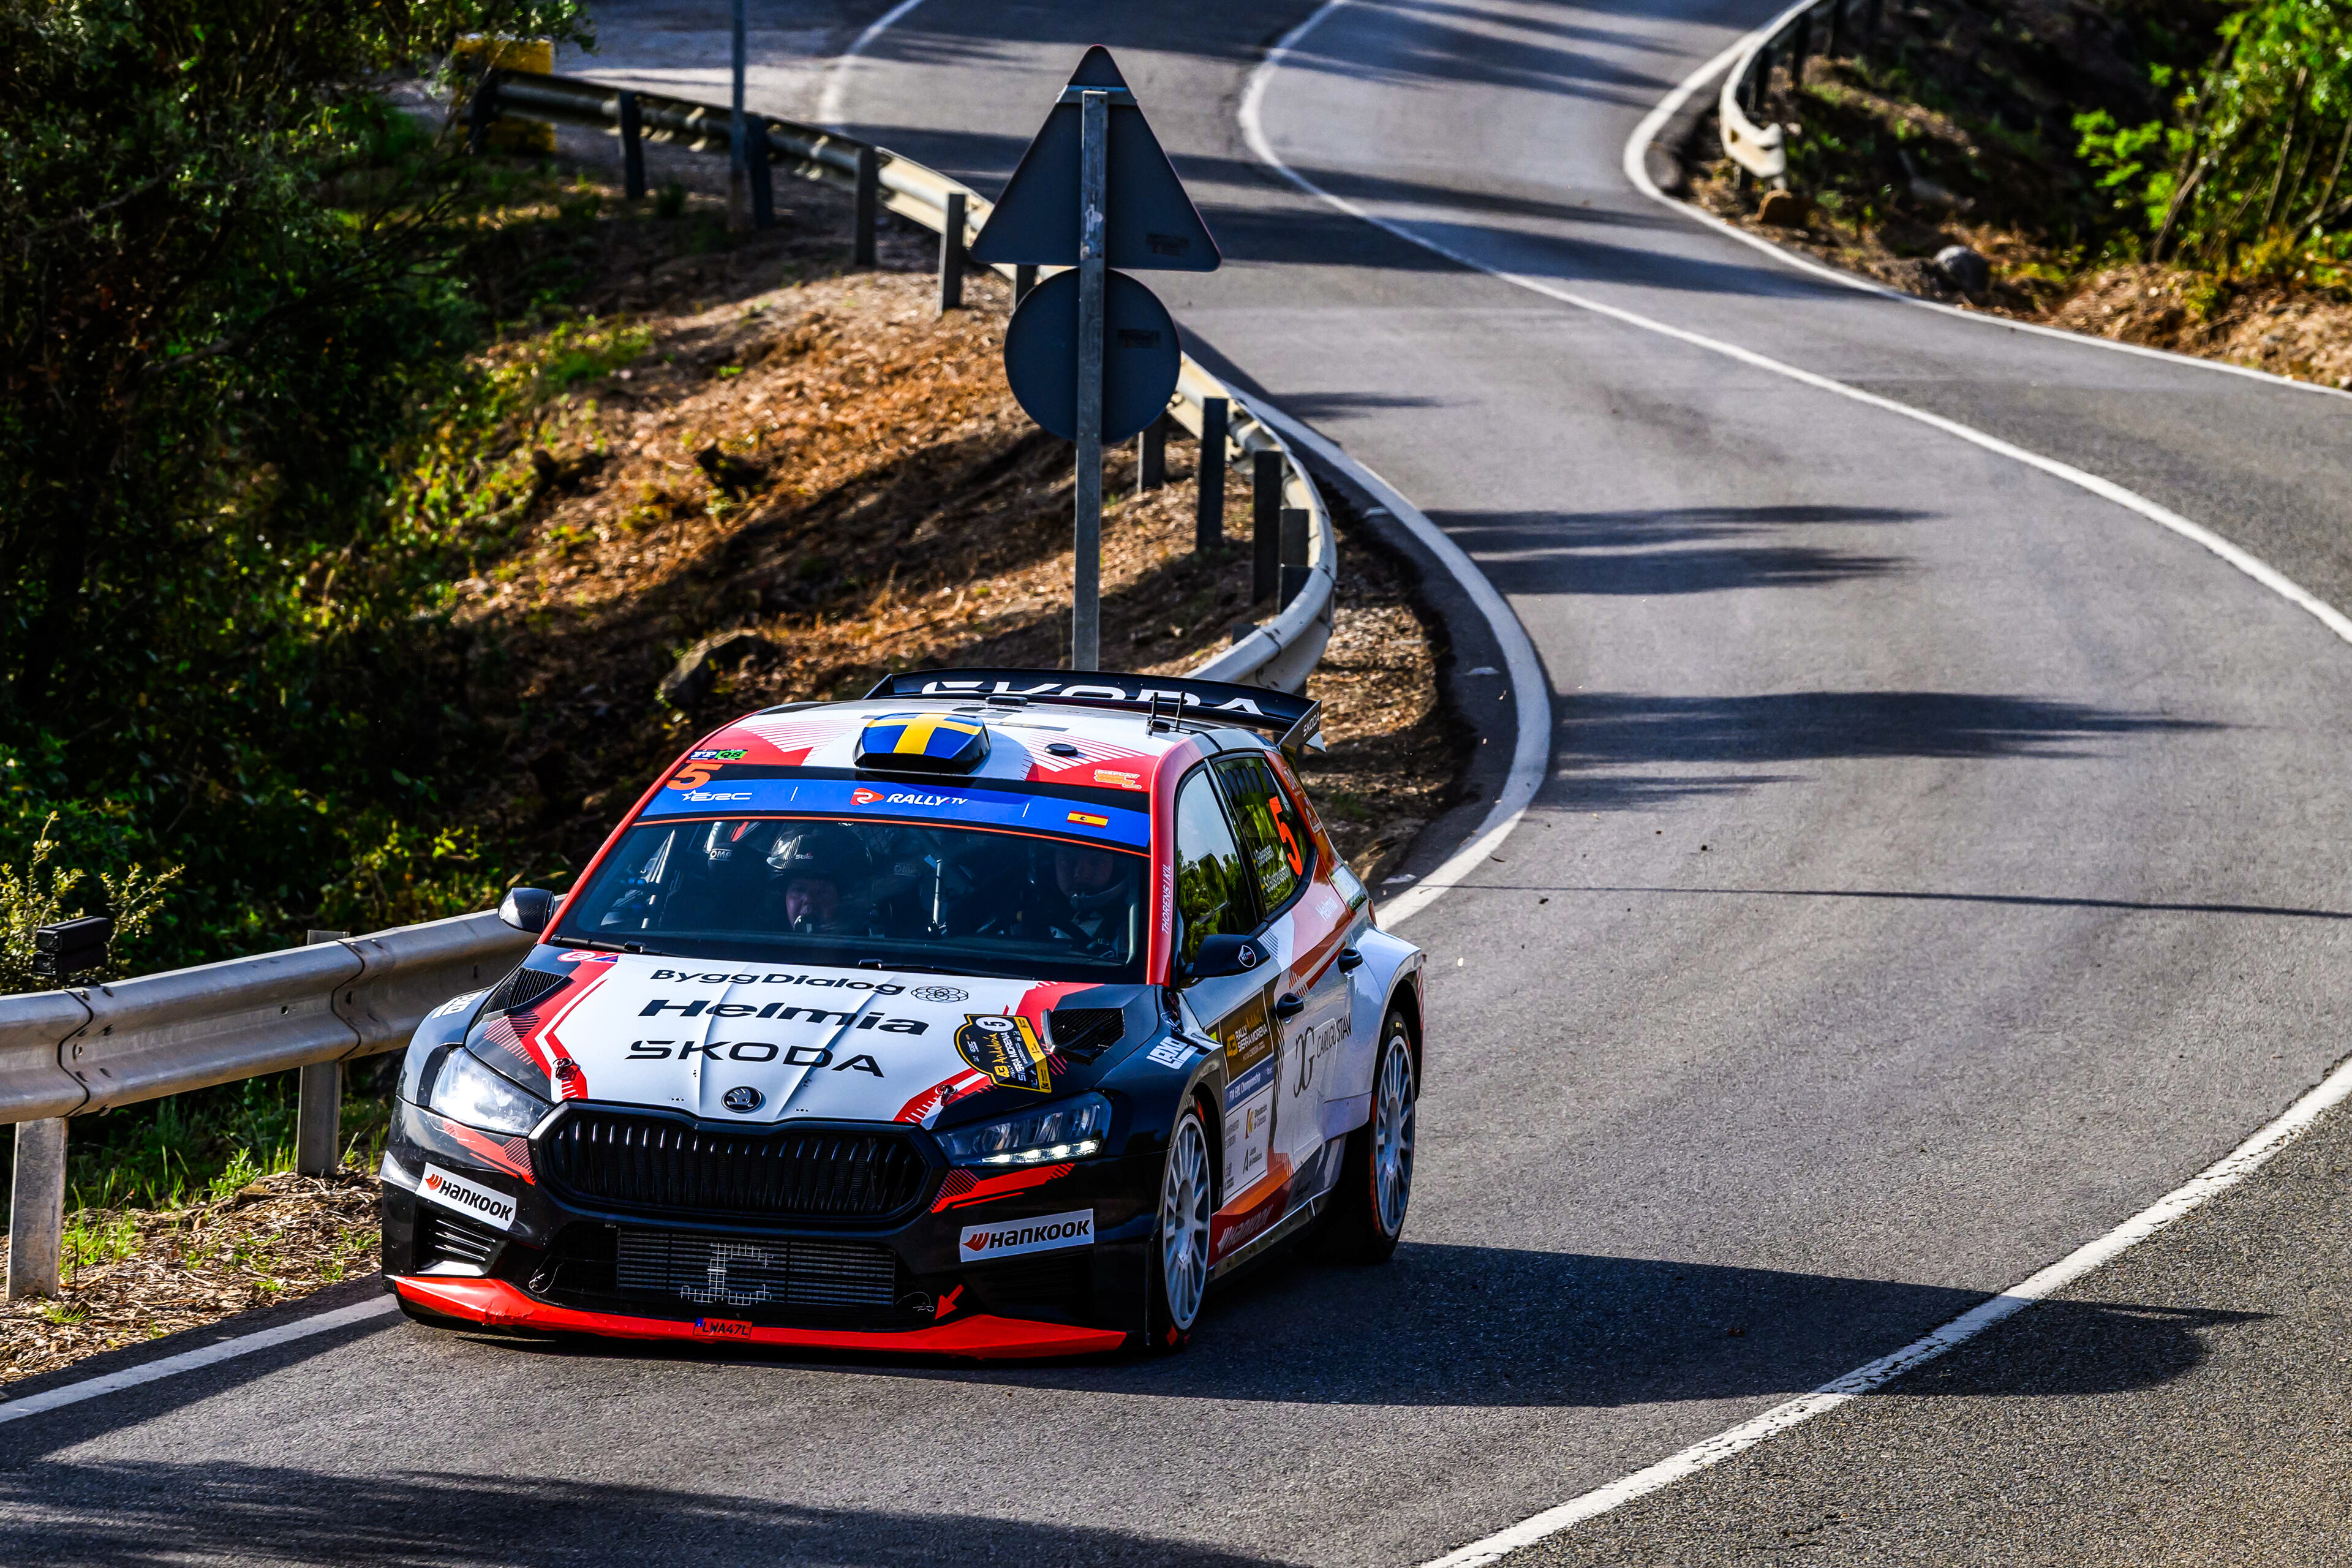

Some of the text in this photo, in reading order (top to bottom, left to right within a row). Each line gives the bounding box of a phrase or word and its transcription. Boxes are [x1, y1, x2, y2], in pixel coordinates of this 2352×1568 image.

[1303, 711, 1320, 737] SKODA
[666, 763, 723, 791] 5
[1269, 796, 1303, 876] 5
[709, 850, 733, 859] OMP
[1162, 884, 1170, 935] THORENS
[1315, 895, 1338, 921] Helmia
[650, 970, 905, 995] ByggDialog
[638, 1000, 929, 1035] Helmia
[1001, 1032, 1017, 1058] MORENA
[1235, 1024, 1247, 1041] RALLY
[624, 1041, 884, 1078] SKODA
[994, 1065, 1009, 1077] 43
[1011, 1058, 1026, 1081] SIERRA
[702, 1321, 748, 1335] LWA47L
